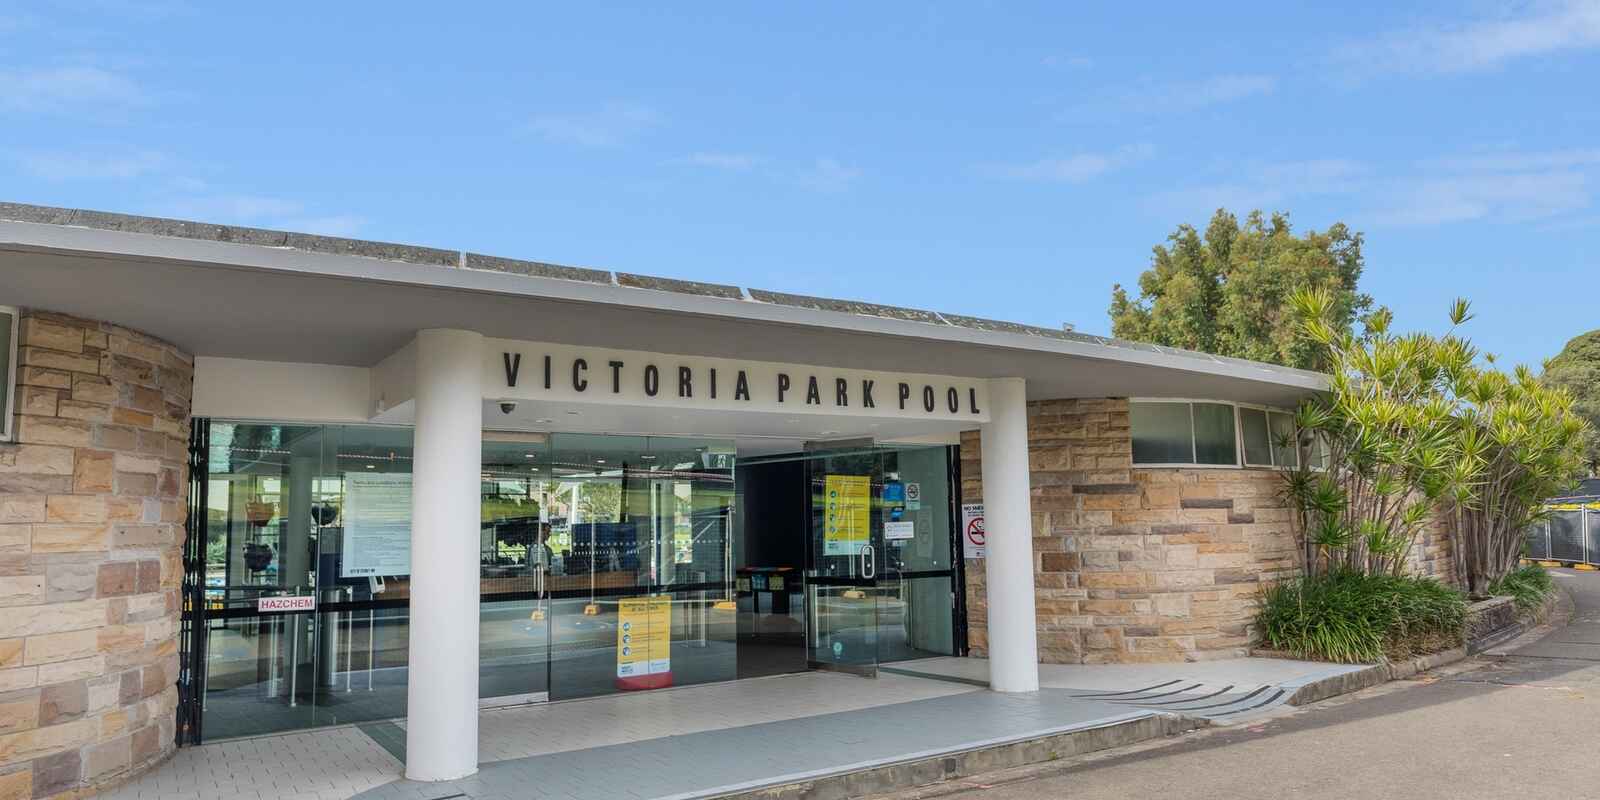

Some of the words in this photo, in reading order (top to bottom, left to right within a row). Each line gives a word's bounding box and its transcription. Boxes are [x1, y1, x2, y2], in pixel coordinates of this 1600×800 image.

[502, 352, 751, 401] VICTORIA
[777, 373, 876, 409] PARK
[897, 382, 981, 415] POOL
[261, 599, 313, 609] HAZCHEM
